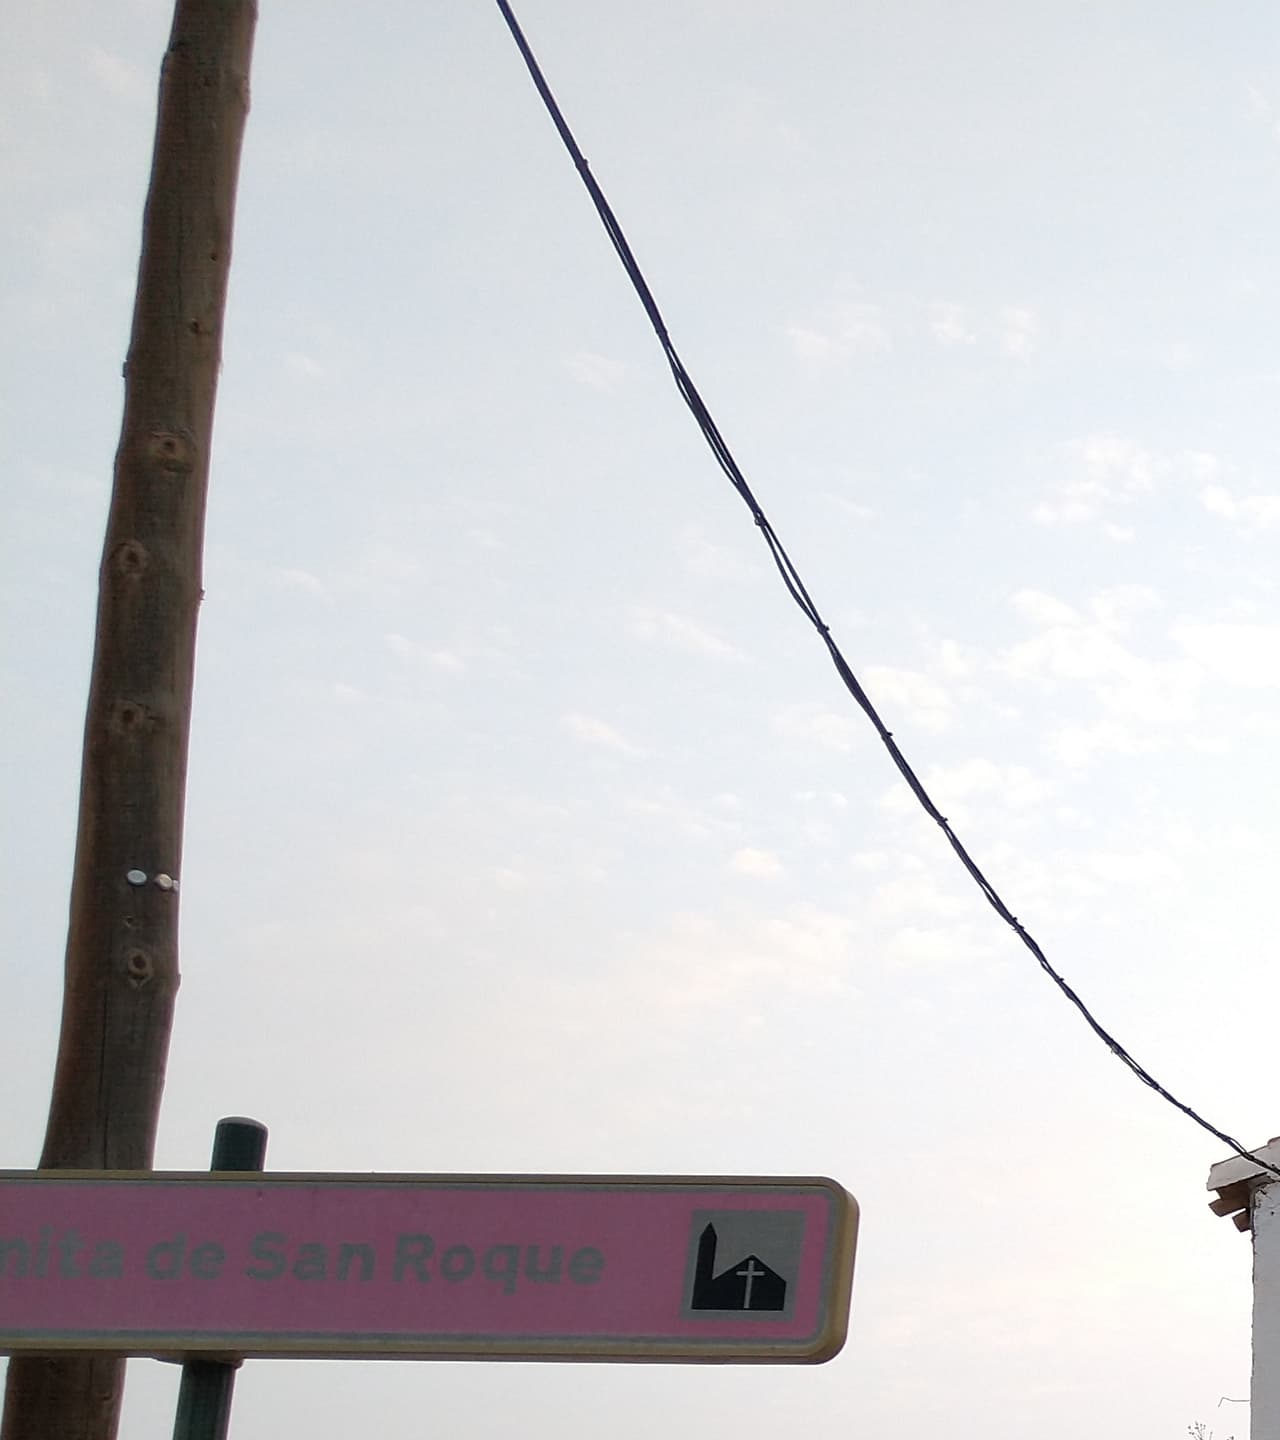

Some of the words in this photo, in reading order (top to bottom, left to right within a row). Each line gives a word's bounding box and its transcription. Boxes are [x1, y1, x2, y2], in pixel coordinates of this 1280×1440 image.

[145, 1231, 226, 1281] de
[245, 1231, 378, 1281] San
[391, 1233, 607, 1296] Roque
